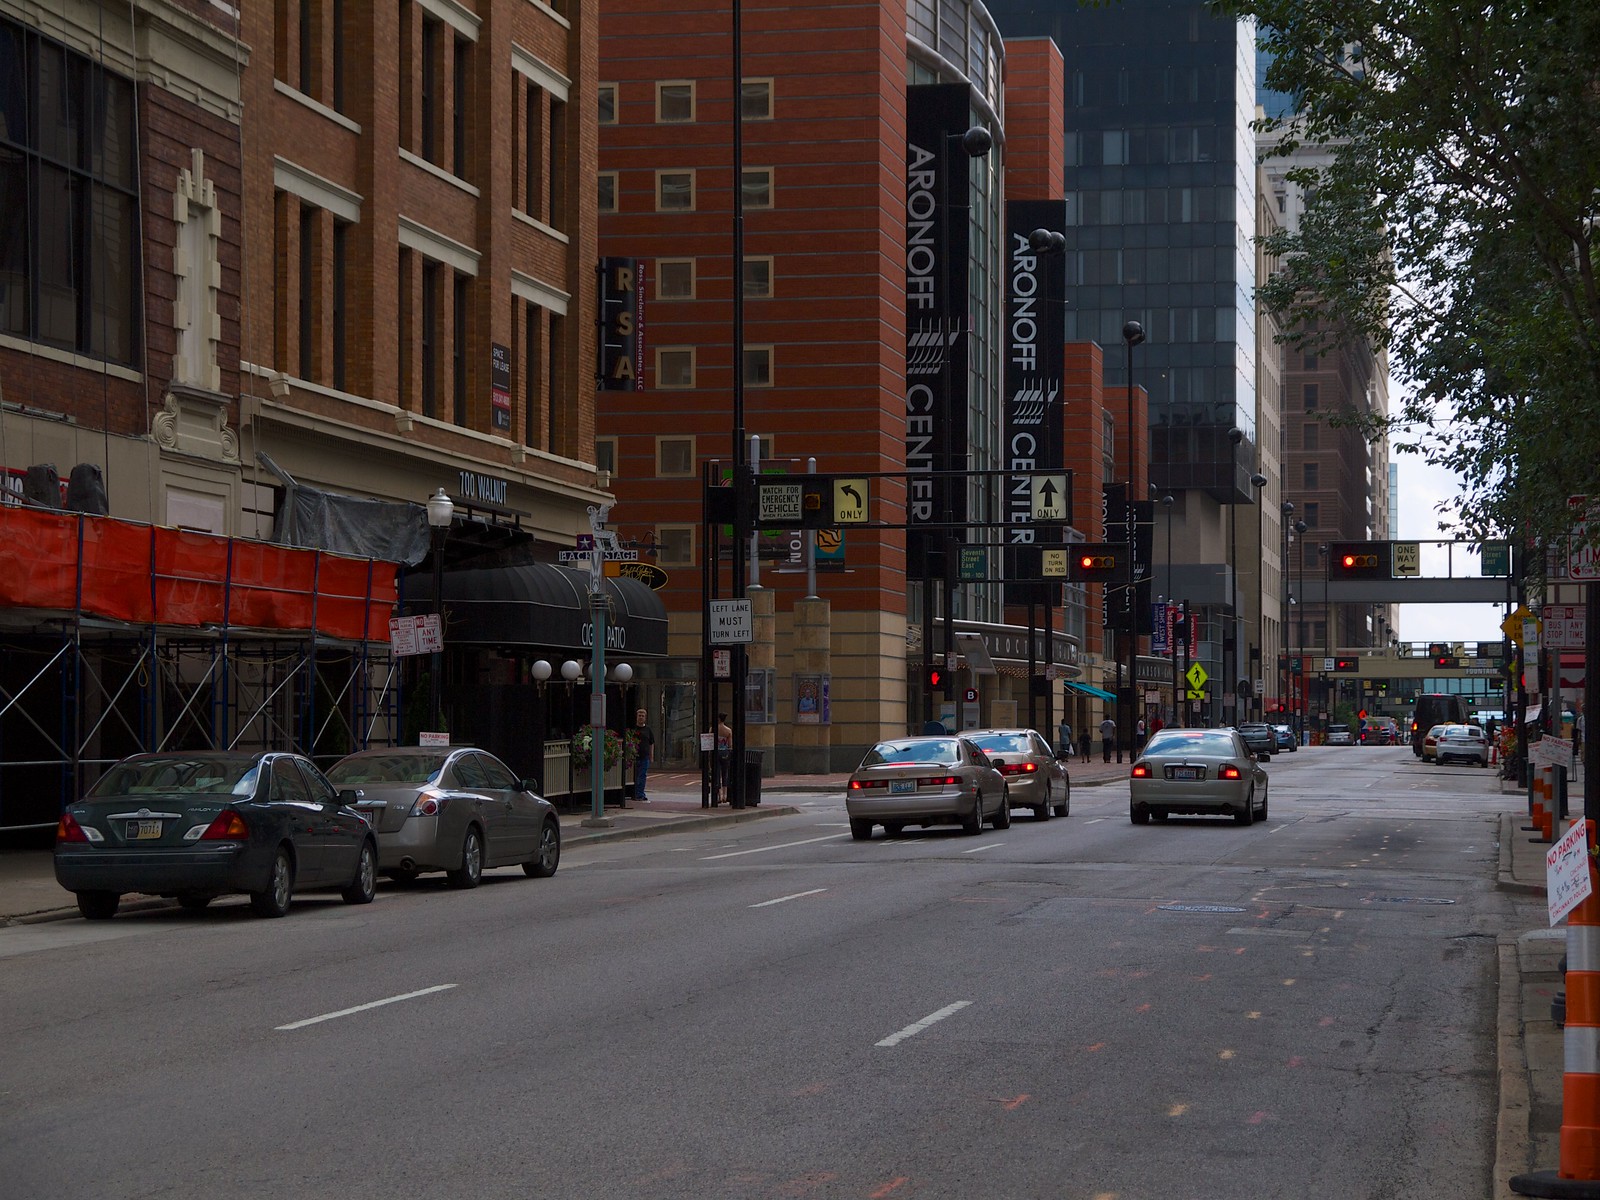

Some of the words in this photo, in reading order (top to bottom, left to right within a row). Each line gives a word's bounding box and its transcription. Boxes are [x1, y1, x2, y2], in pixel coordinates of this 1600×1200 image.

[907, 143, 936, 310] ARONOFF
[1012, 231, 1038, 372] ARONOFF
[906, 383, 934, 521] CENTER
[459, 471, 475, 497] 700
[477, 474, 507, 505] WALNUT
[762, 494, 800, 504] EMERGENCY
[762, 504, 799, 513] VEHICLE
[1037, 508, 1060, 518] ONLY
[840, 510, 863, 520] ONLY
[604, 551, 637, 560] STAGE
[719, 616, 742, 626] MUST
[422, 628, 436, 636] ANY
[581, 622, 592, 646] CIG
[606, 626, 626, 649] PATIO
[1569, 630, 1584, 638] TIME
[422, 637, 437, 645] TIME
[968, 691, 974, 699] B
[1552, 738, 1572, 748] PARKING
[1548, 850, 1557, 868] NO
[1558, 823, 1586, 859] PARKING
[1573, 884, 1587, 901] POLICE
